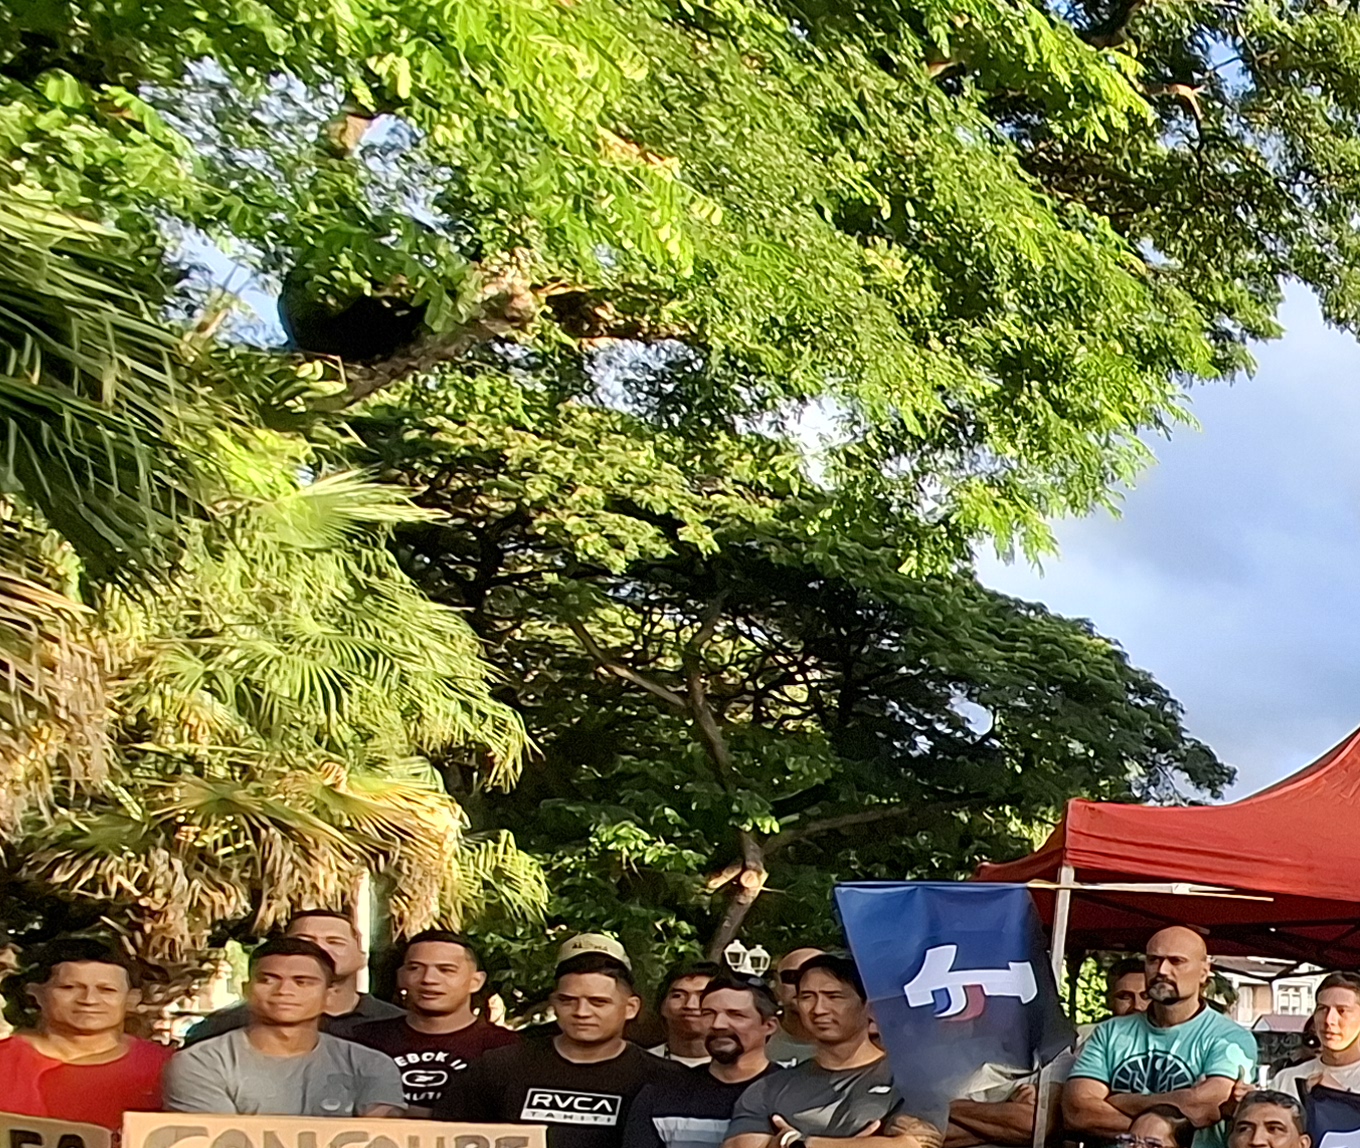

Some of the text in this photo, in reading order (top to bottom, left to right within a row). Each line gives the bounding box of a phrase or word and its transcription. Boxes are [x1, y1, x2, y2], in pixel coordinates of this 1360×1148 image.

[393, 1051, 450, 1068] EBOK
[530, 1093, 613, 1113] RVCA
[530, 1110, 612, 1123] TAHITI
